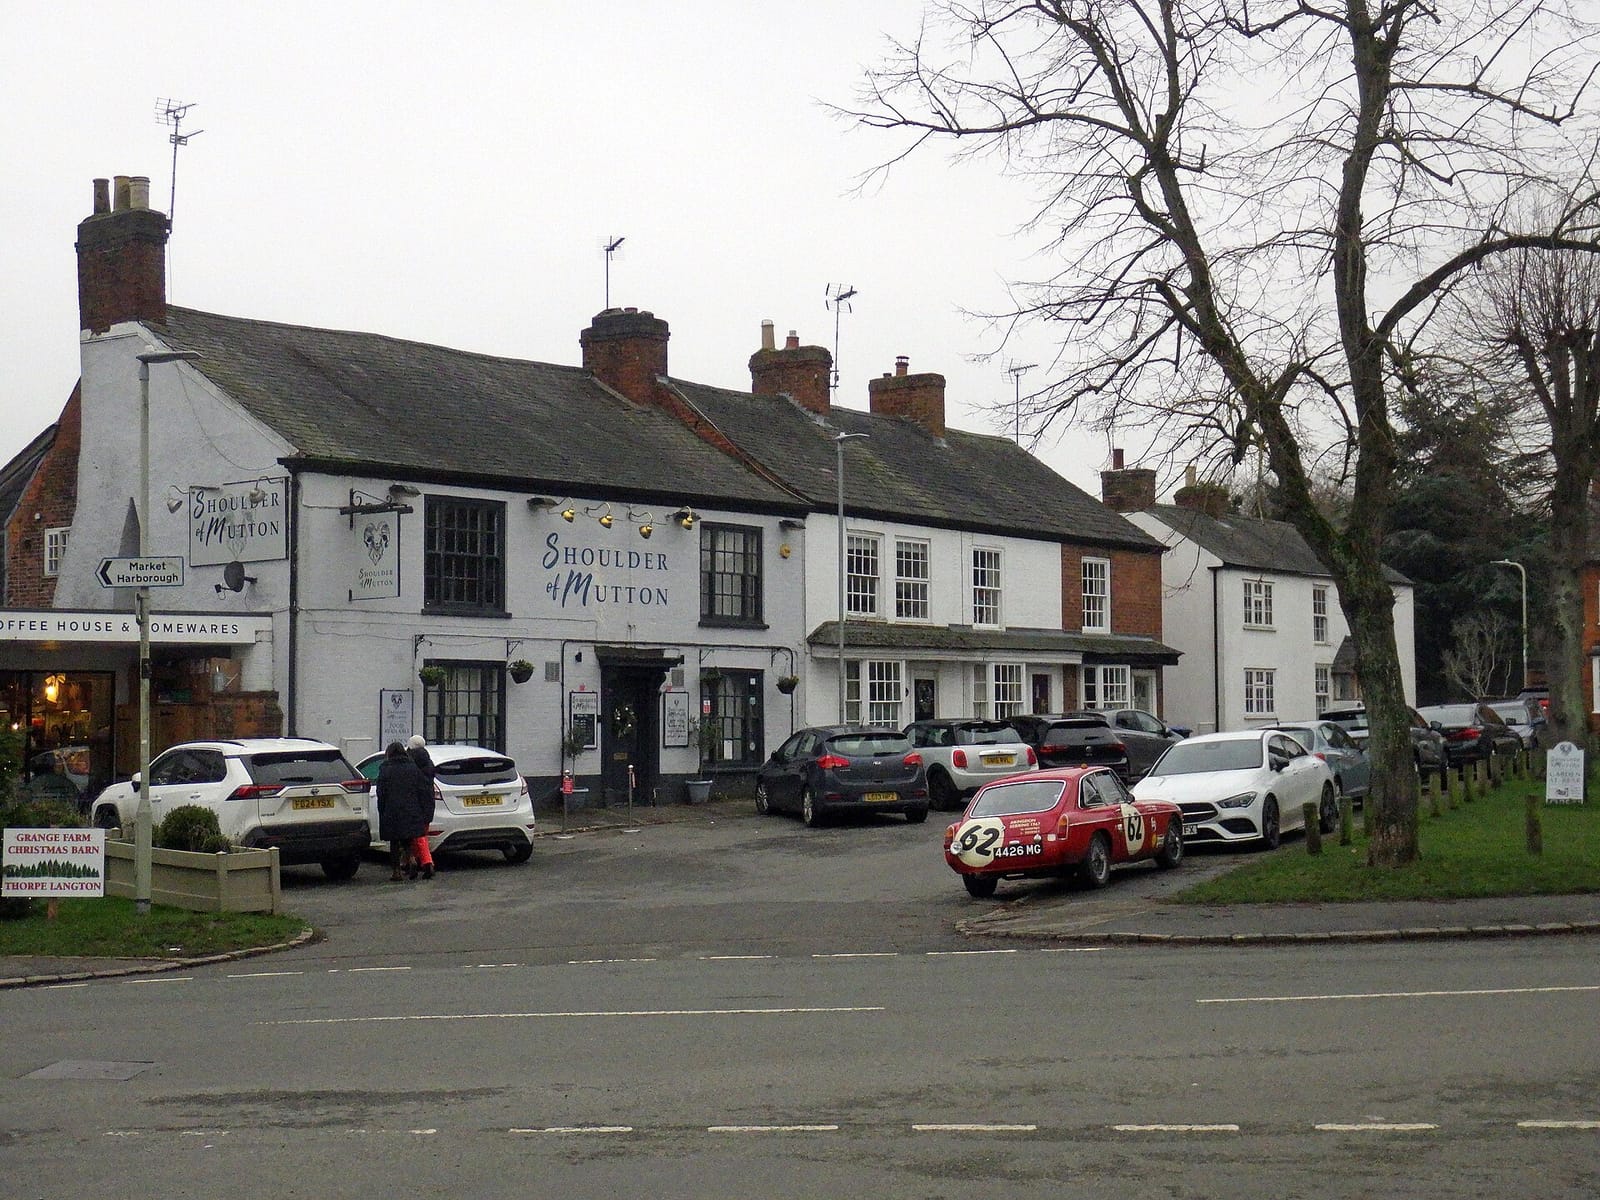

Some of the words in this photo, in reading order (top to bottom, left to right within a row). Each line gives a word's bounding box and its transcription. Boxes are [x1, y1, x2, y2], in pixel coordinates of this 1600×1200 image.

[206, 516, 279, 547] MUTTON
[542, 532, 669, 570] SHOULDER
[129, 562, 166, 571] Market
[117, 573, 179, 584] Harborough
[562, 569, 669, 608] MUTTON
[57, 621, 113, 632] HOUSE
[121, 622, 130, 632] &
[139, 622, 239, 634] OMEWARES
[16, 833, 60, 842] GRANGE
[63, 833, 92, 842] FARM
[960, 824, 1000, 857] 62
[8, 846, 68, 854] CHRISTMAS
[71, 846, 100, 854] BARN
[995, 846, 1024, 857] 4426
[1026, 844, 1041, 855] MG
[5, 882, 48, 890] THORPE
[50, 882, 101, 890] LANGTON
